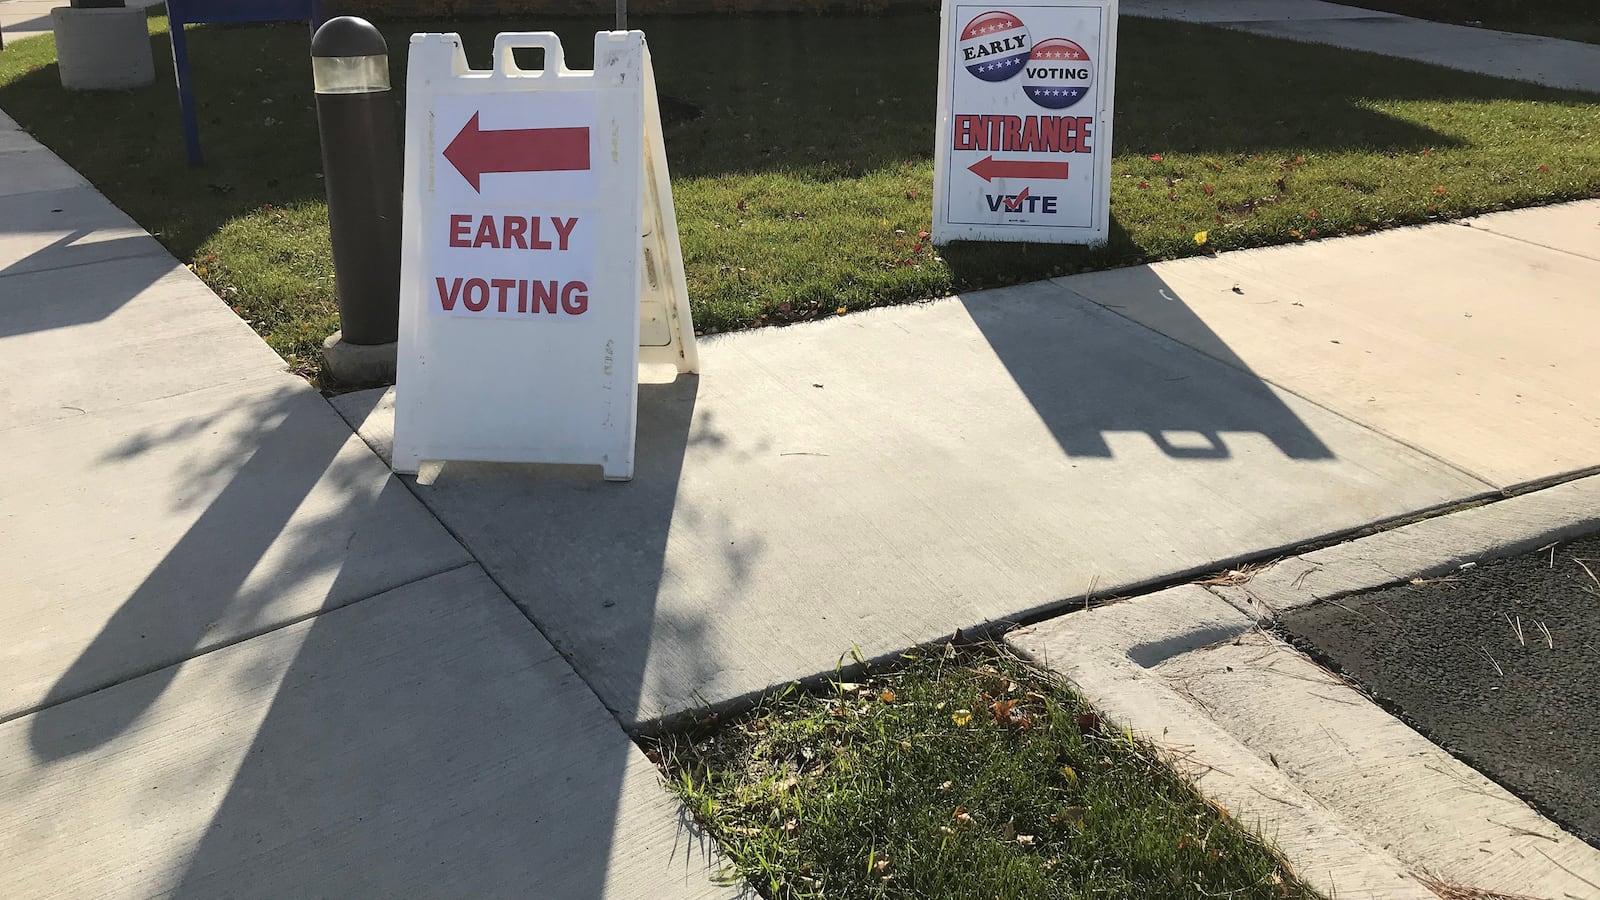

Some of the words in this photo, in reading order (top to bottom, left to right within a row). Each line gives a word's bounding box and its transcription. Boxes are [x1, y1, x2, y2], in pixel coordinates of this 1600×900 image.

[962, 34, 1027, 61] EARLY
[1026, 67, 1089, 80] VOTING
[954, 114, 1093, 153] ENTRANCE
[449, 214, 579, 251] EARLY
[435, 277, 589, 316] VOTING
